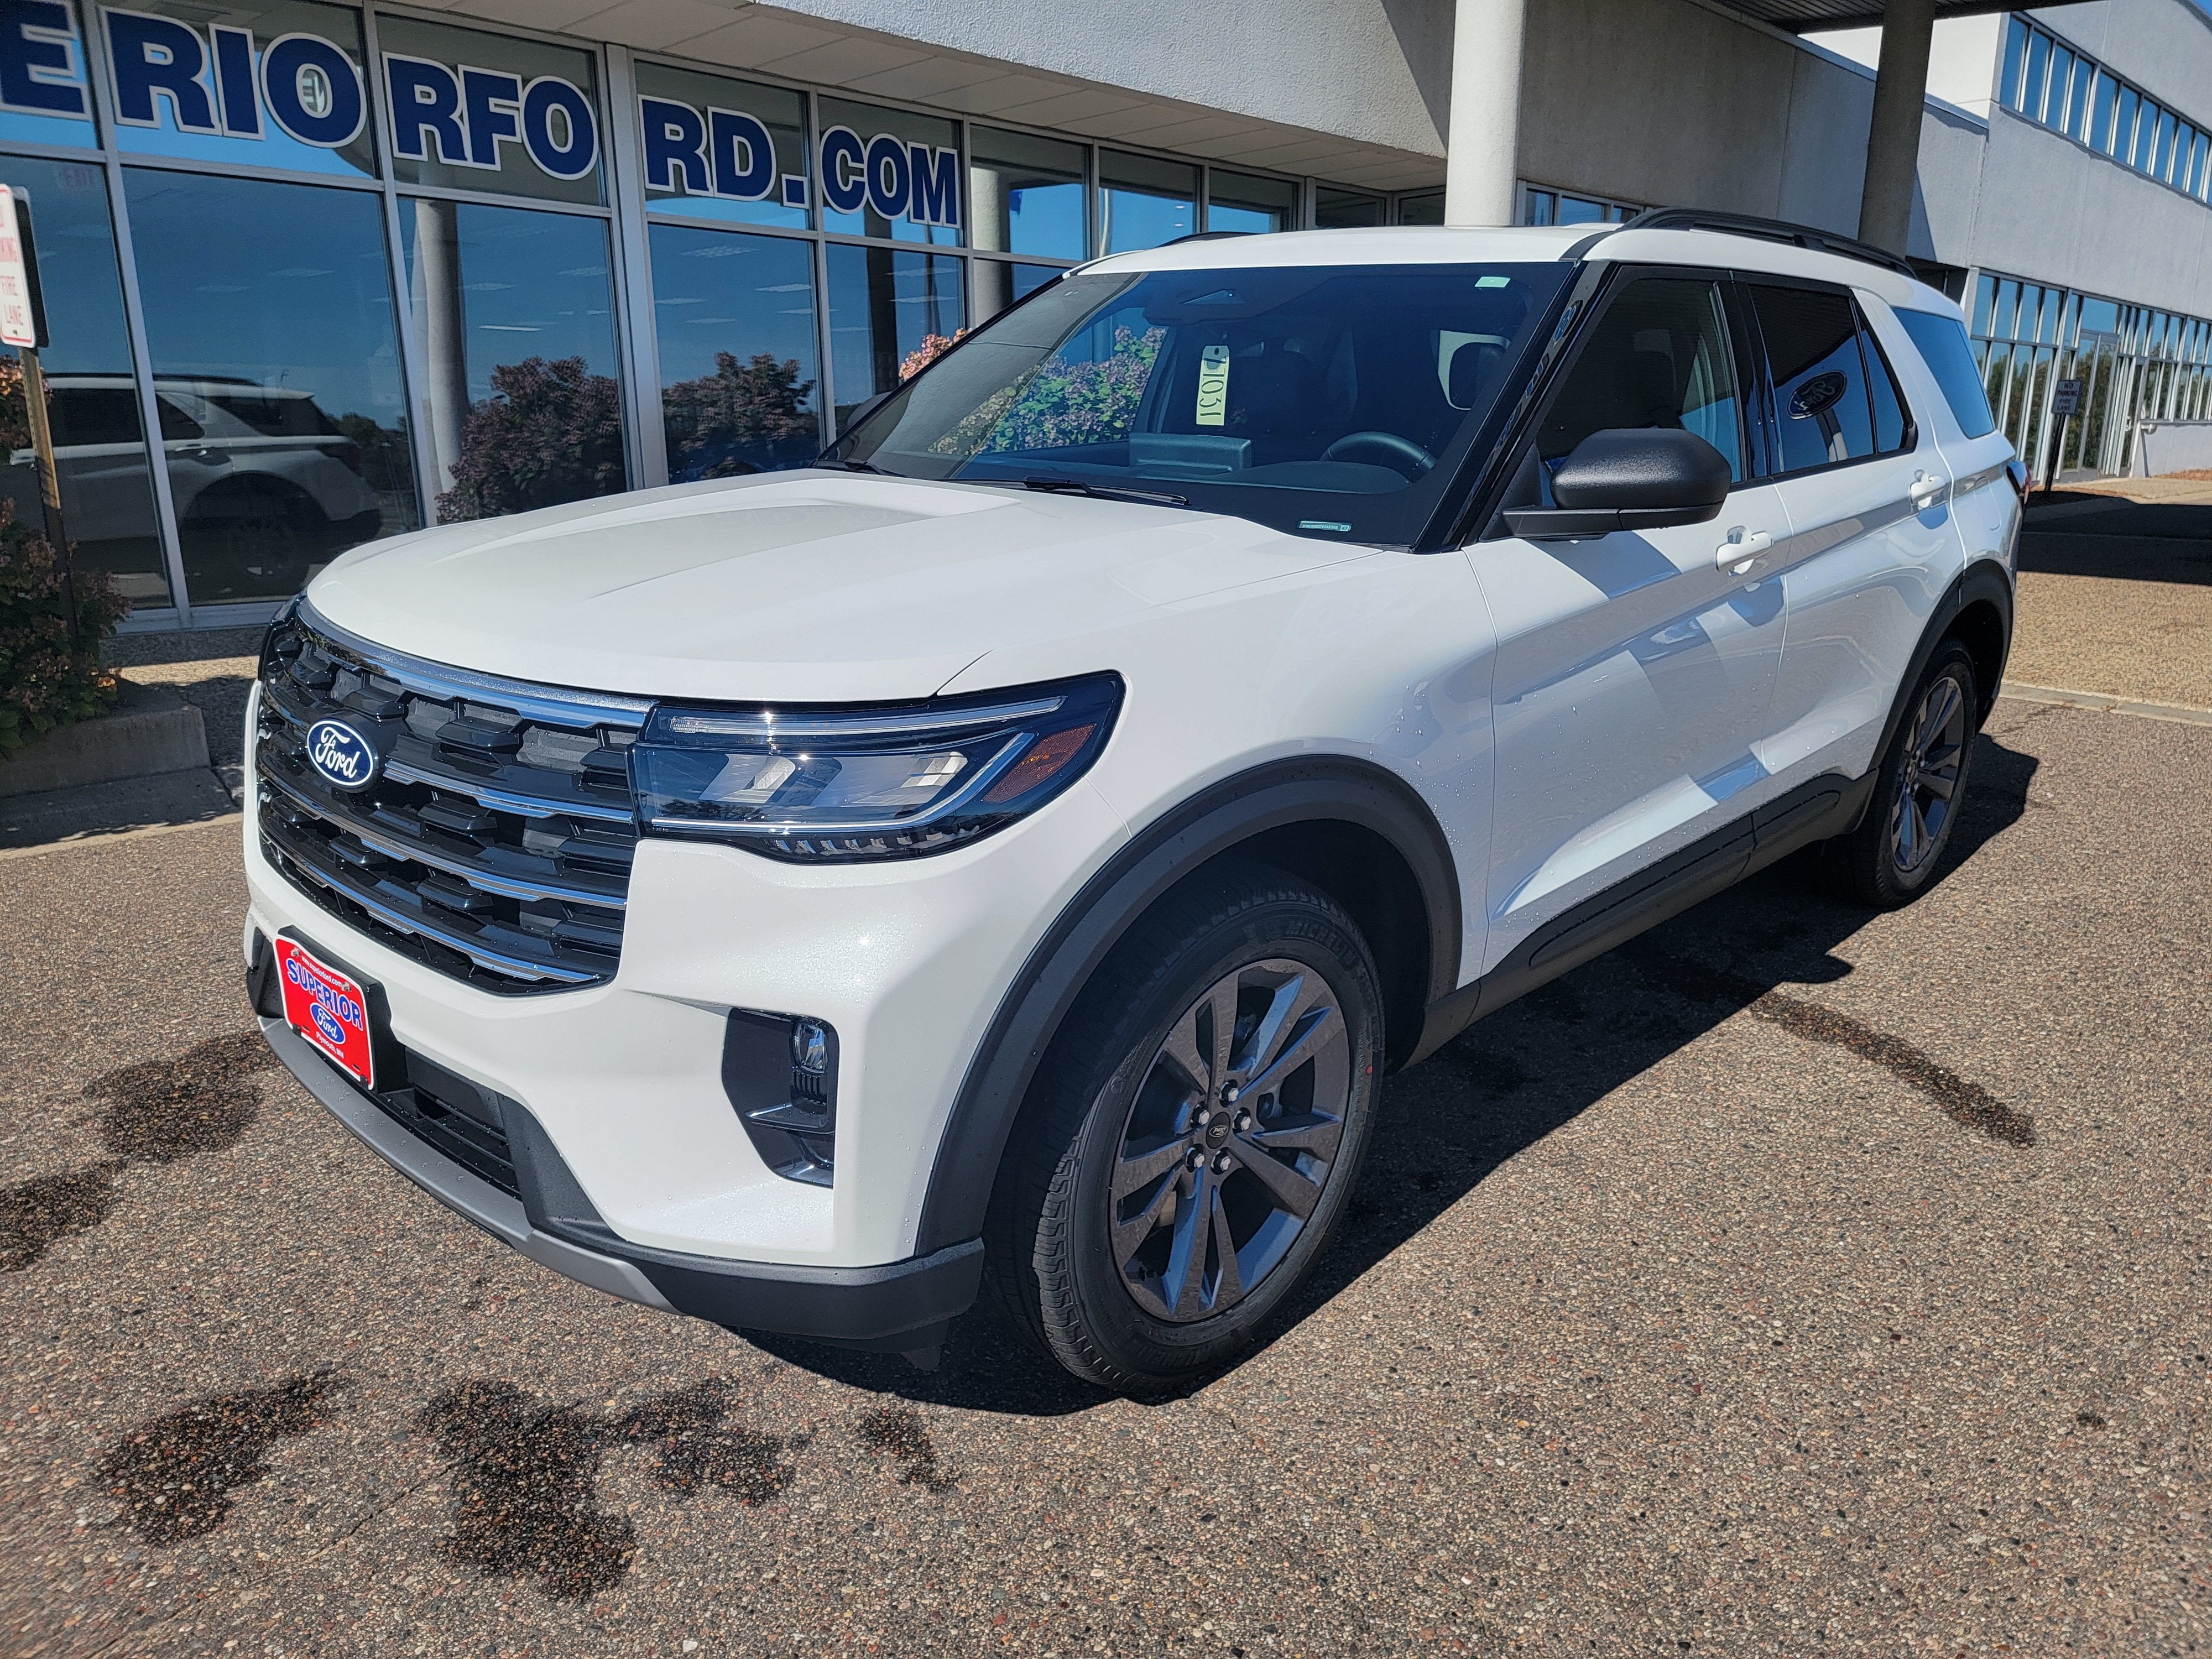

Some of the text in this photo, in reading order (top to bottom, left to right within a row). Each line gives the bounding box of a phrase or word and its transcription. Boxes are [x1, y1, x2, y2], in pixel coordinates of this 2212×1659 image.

[4, 305, 24, 326] LANE
[1199, 356, 1227, 417] 71031
[315, 726, 361, 779] Ford
[286, 957, 363, 1032] SUPERIOR
[317, 1008, 338, 1039] Ford
[336, 1047, 345, 1059] MN
